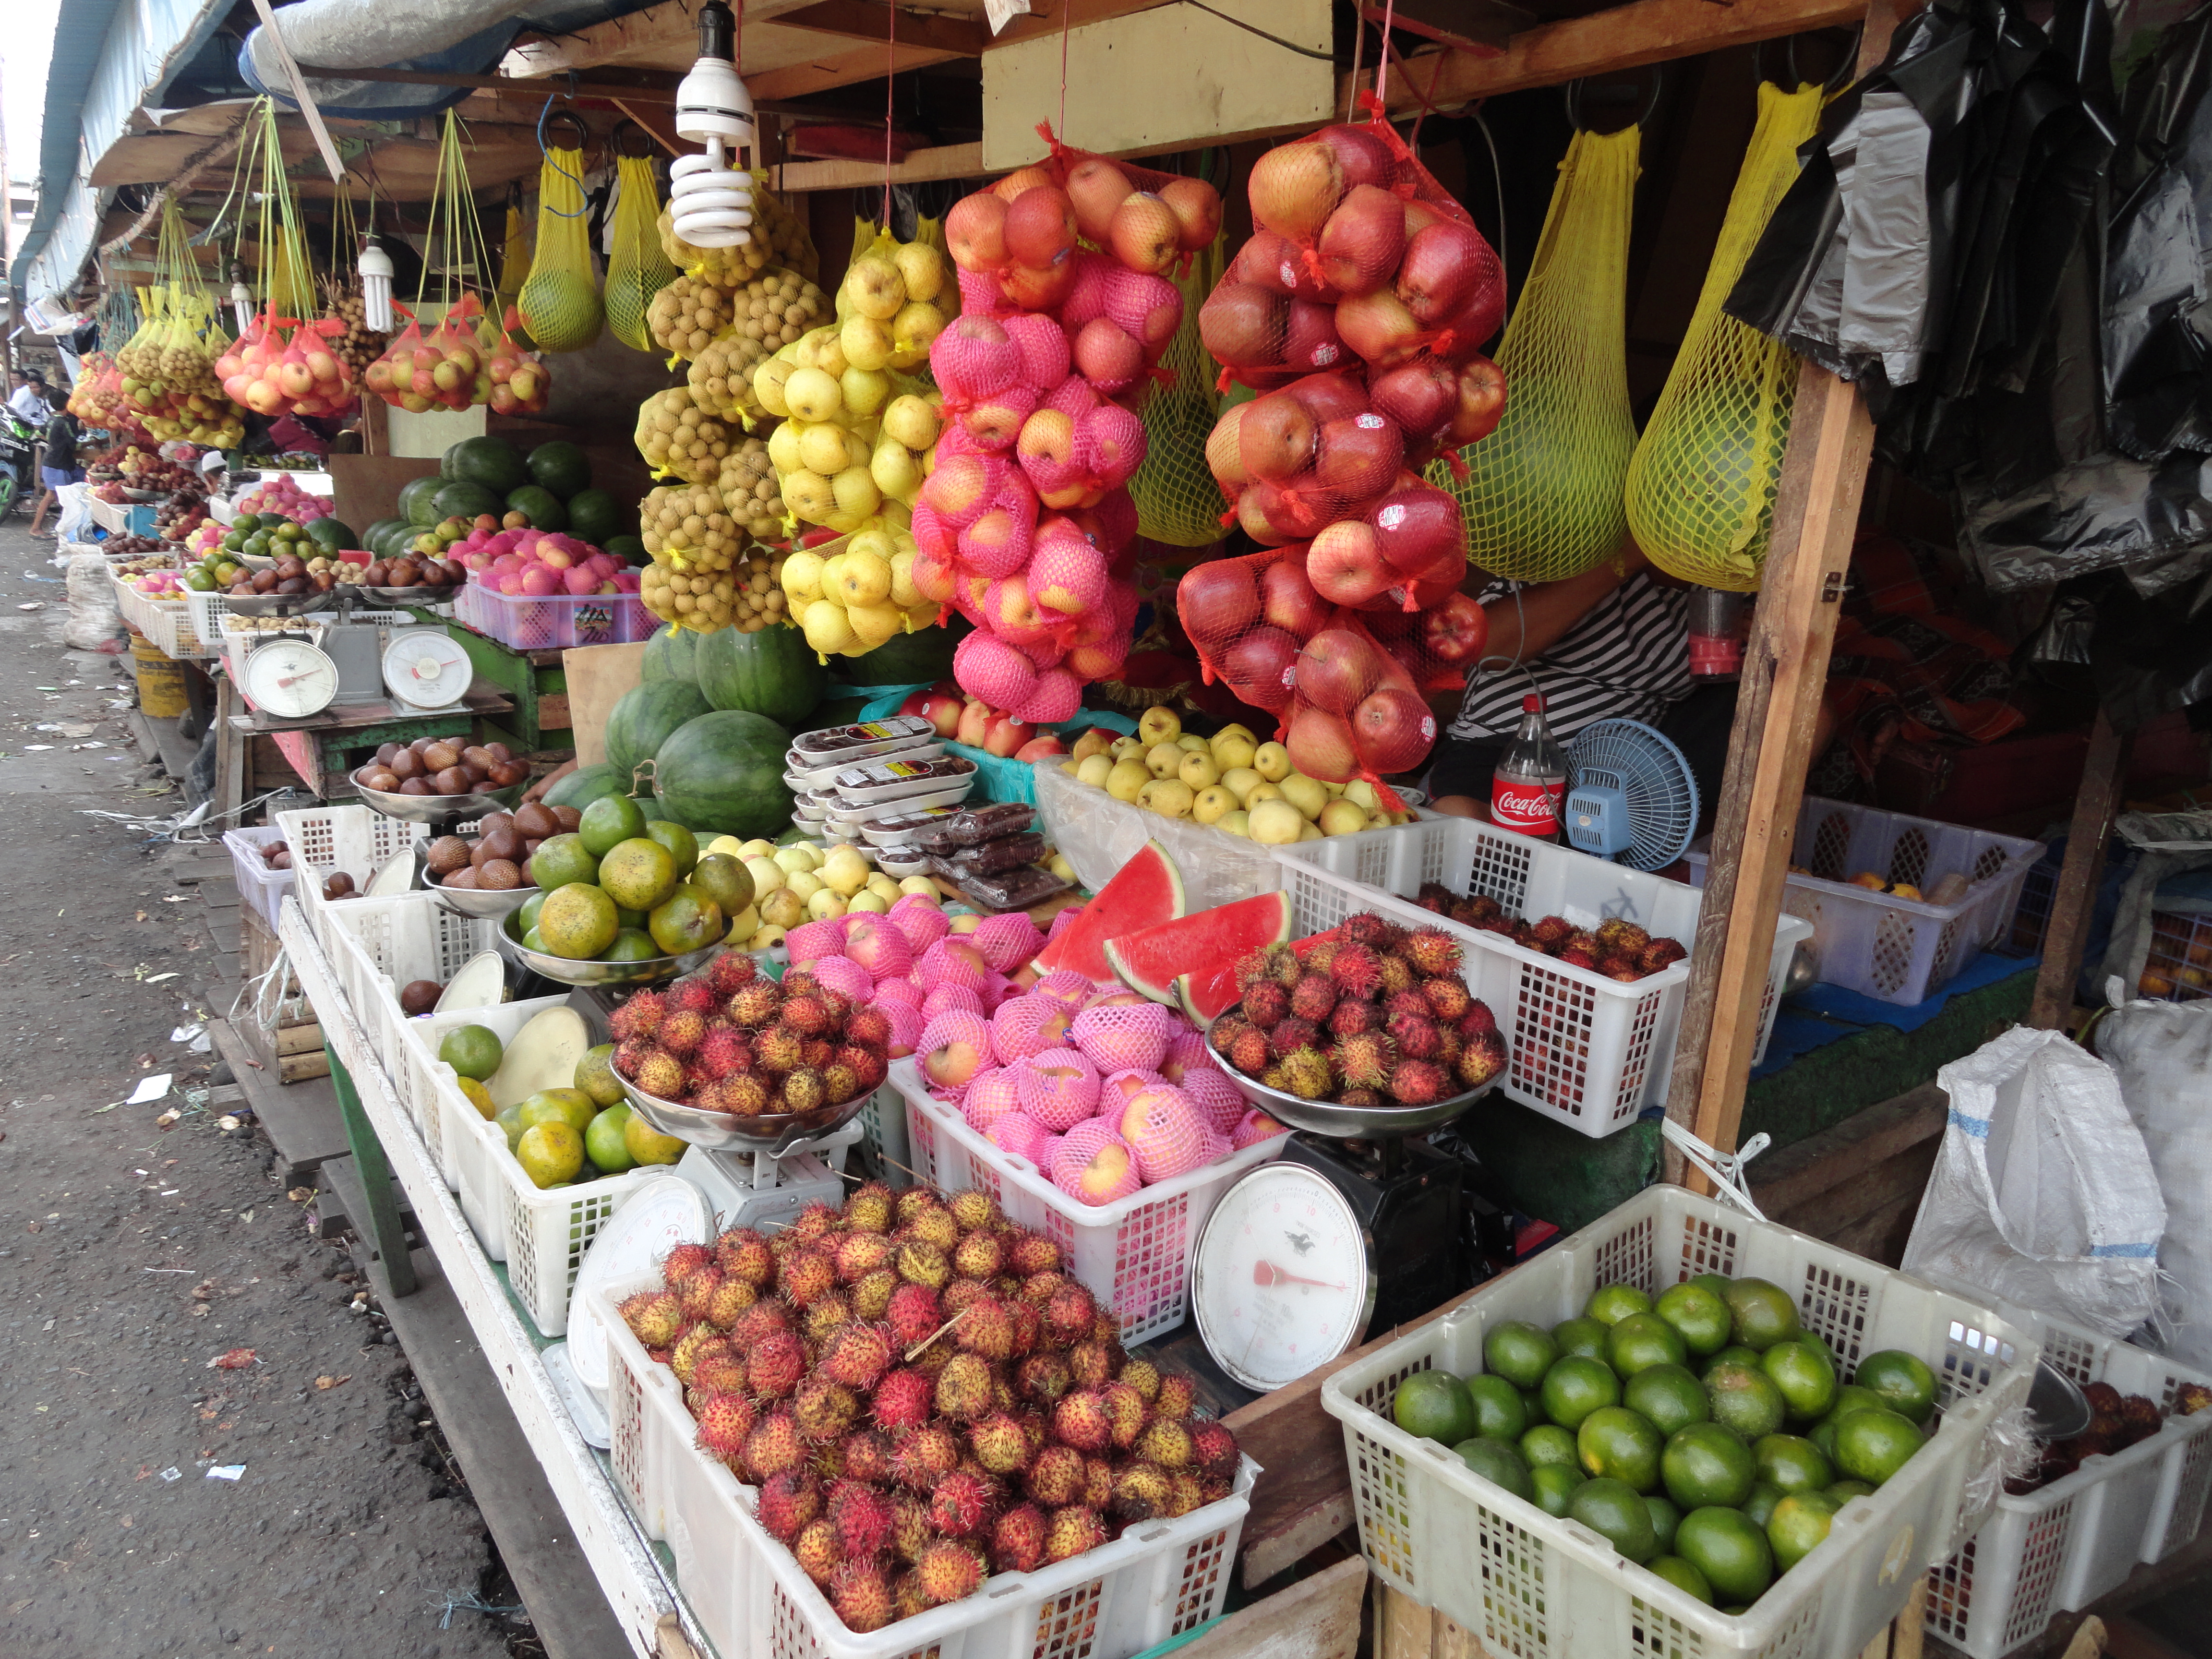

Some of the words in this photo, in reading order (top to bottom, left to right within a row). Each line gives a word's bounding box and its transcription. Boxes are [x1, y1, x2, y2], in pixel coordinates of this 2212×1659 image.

[1498, 792, 1561, 816] Coca-Cola
[1273, 1203, 1280, 1213] 9
[1307, 1205, 1316, 1216] 10
[1321, 1323, 1328, 1334] 3
[1288, 1343, 1297, 1354] 4
